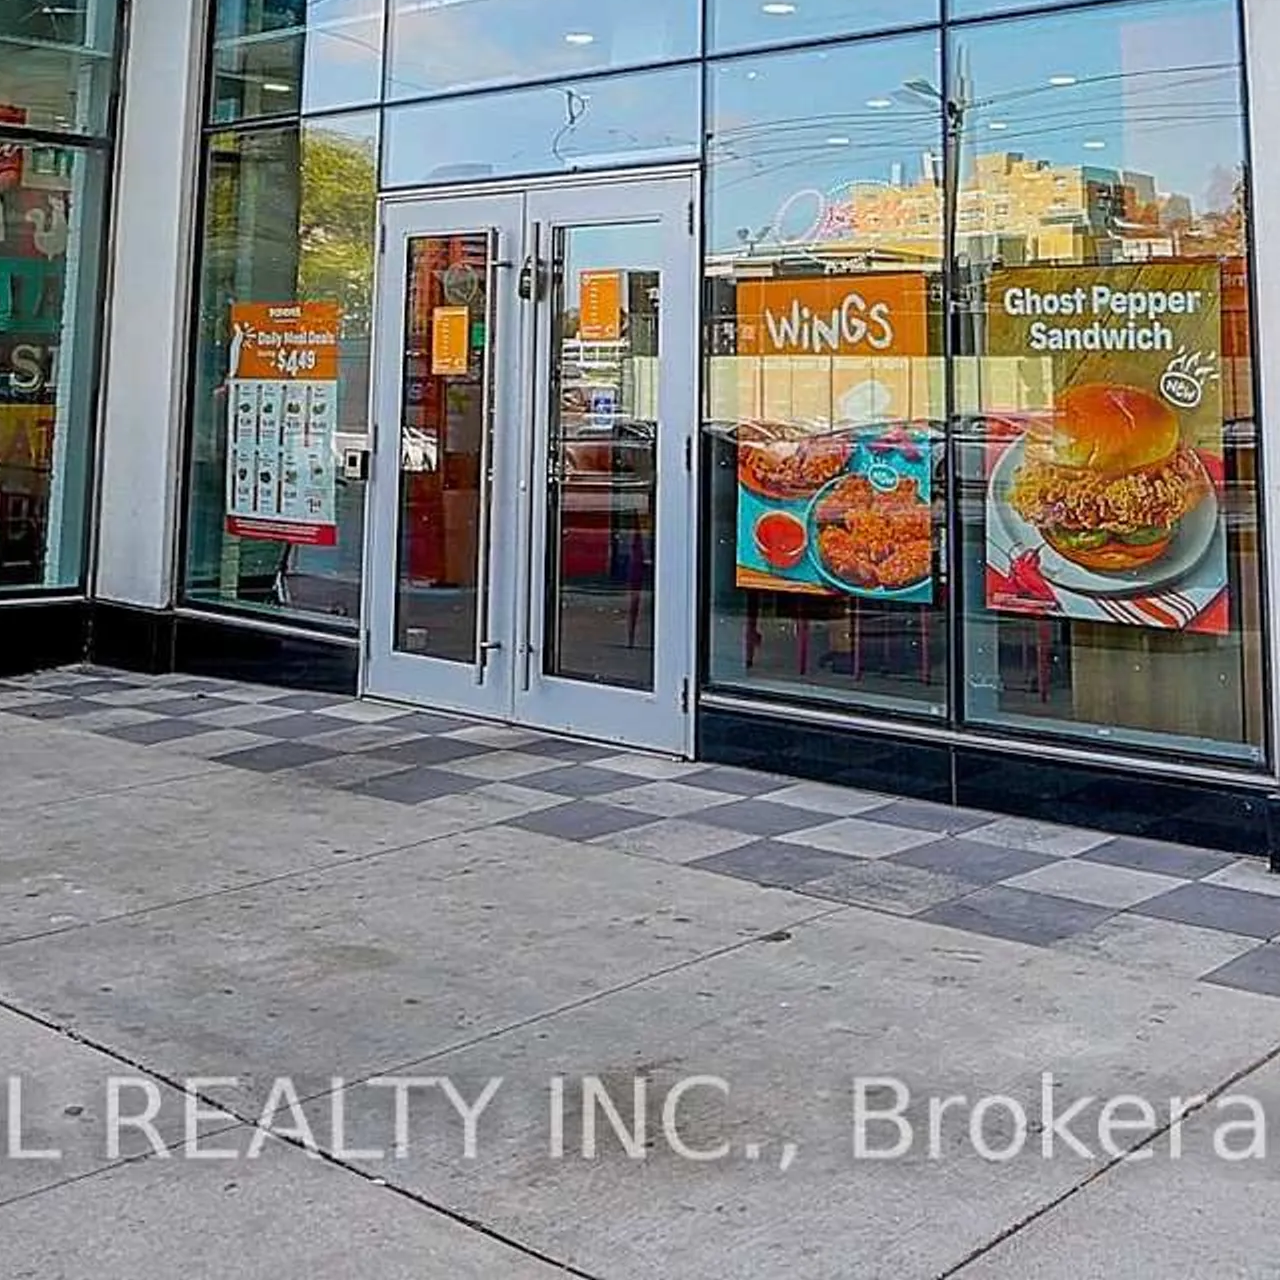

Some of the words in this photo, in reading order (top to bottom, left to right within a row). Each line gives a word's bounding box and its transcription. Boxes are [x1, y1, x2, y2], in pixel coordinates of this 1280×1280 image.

[1003, 287, 1087, 316] Ghost
[1091, 285, 1202, 319] Pepper
[1029, 322, 1173, 350] Sandwich
